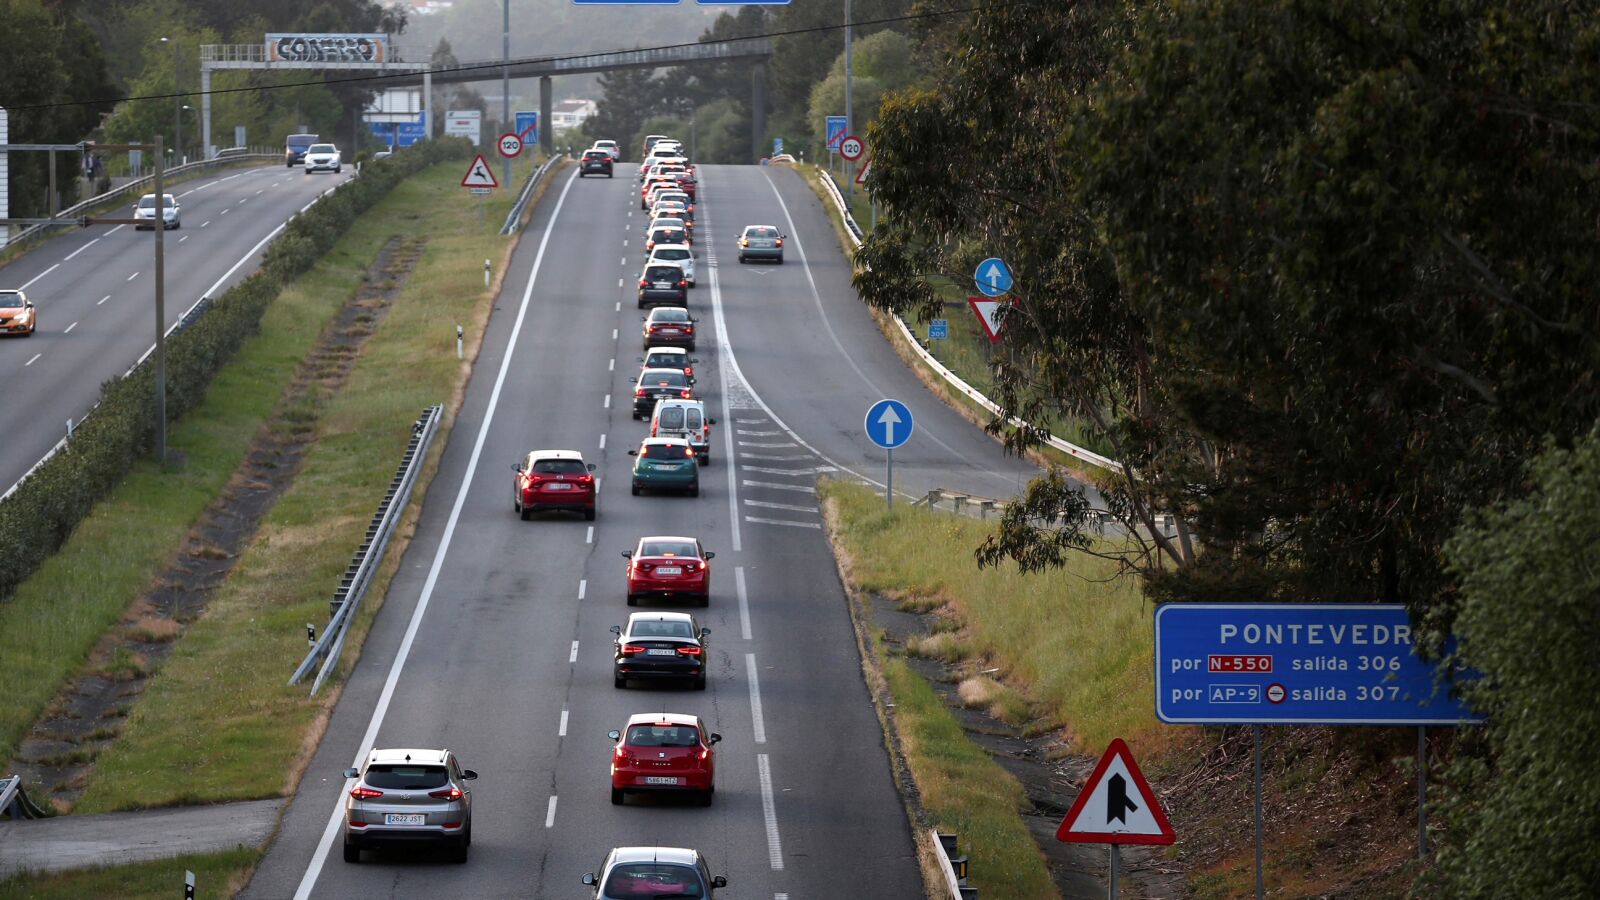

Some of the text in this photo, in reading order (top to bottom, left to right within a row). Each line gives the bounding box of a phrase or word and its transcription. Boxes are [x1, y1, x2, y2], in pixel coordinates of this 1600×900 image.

[502, 141, 519, 150] 120
[844, 144, 860, 153] 120
[1220, 623, 1411, 645] PONTEVEDR
[1171, 655, 1401, 674] por N-550 salida 306
[1172, 688, 1203, 704] por
[1211, 688, 1258, 701] AP-9
[1291, 686, 1347, 701] salida
[1355, 685, 1401, 701] 307
